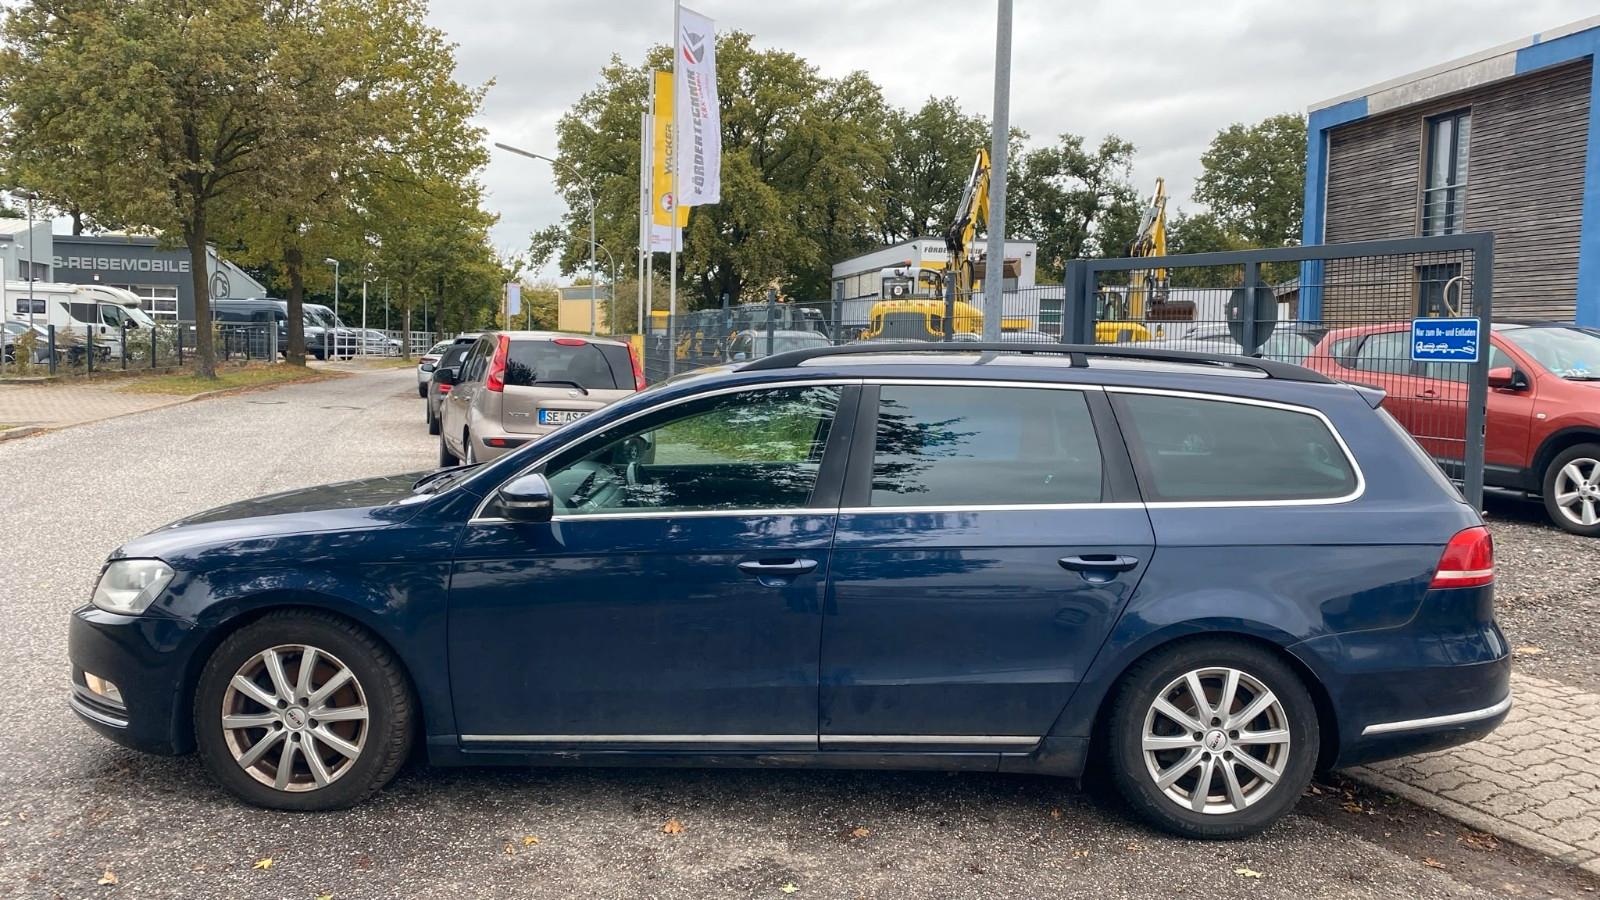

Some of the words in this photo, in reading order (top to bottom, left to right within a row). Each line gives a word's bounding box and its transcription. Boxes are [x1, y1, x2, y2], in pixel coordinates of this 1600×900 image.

[1416, 328, 1425, 336] Nur
[1436, 327, 1445, 336] Be-
[1445, 327, 1454, 336] und
[1455, 327, 1476, 336] Entladen
[546, 411, 559, 422] SE
